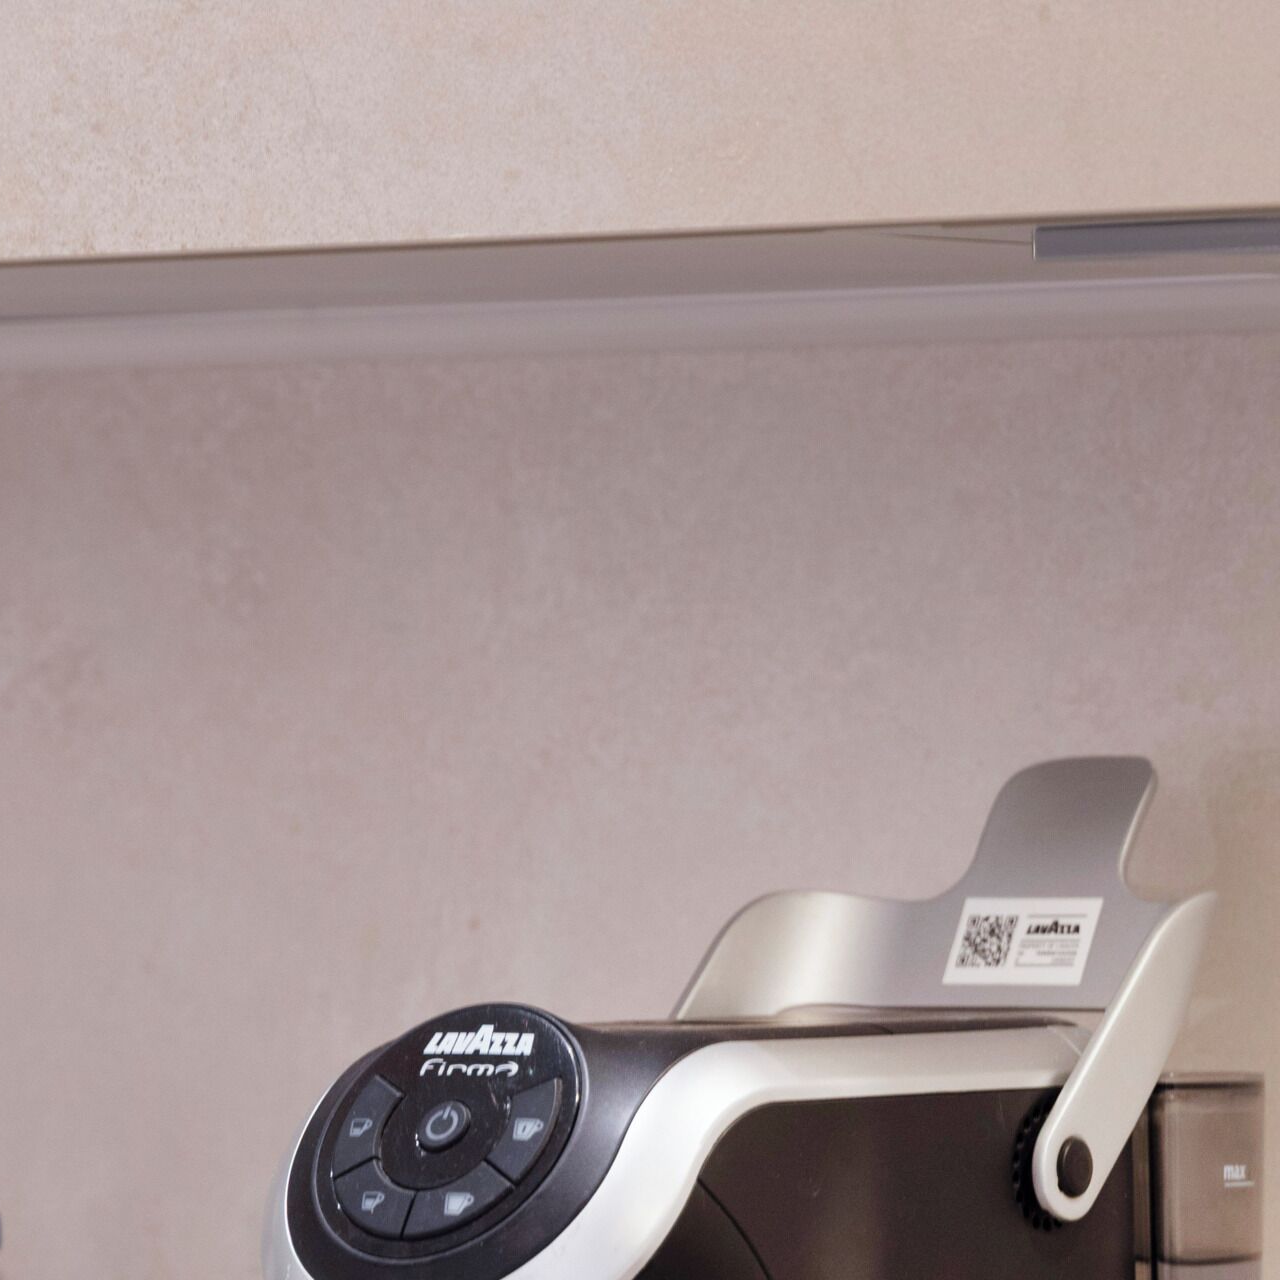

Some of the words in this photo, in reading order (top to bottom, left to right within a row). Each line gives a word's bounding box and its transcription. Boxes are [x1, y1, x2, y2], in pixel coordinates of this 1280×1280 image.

[1026, 920, 1080, 935] LAVAZZA
[423, 1024, 535, 1056] LAVAZZA
[1223, 1164, 1247, 1181] max
